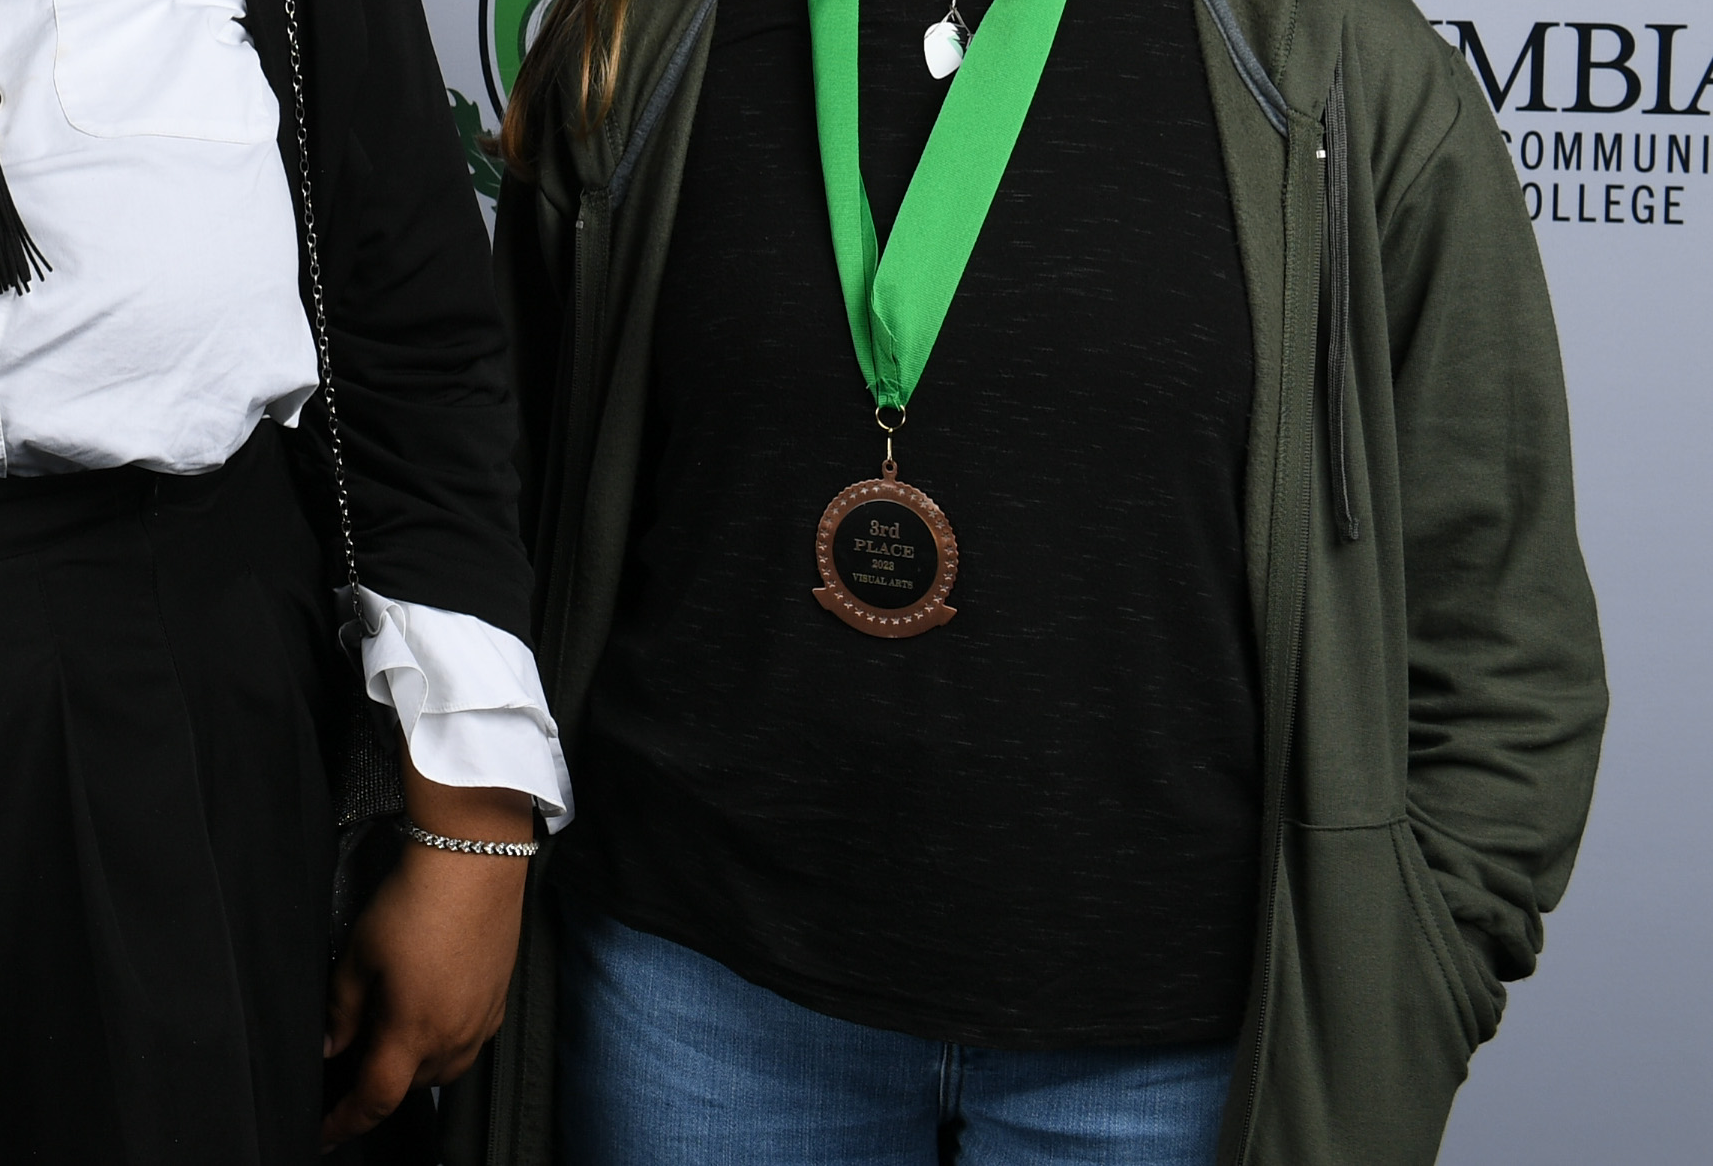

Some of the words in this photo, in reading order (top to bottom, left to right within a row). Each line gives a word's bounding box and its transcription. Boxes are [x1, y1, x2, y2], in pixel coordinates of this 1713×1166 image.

[1500, 130, 1710, 175] OMMUNI
[1522, 182, 1685, 225] OLLEGE
[869, 519, 900, 539] 3rd
[853, 538, 914, 558] PLACE
[852, 572, 886, 585] VISUAL
[888, 578, 913, 589] ARTS
